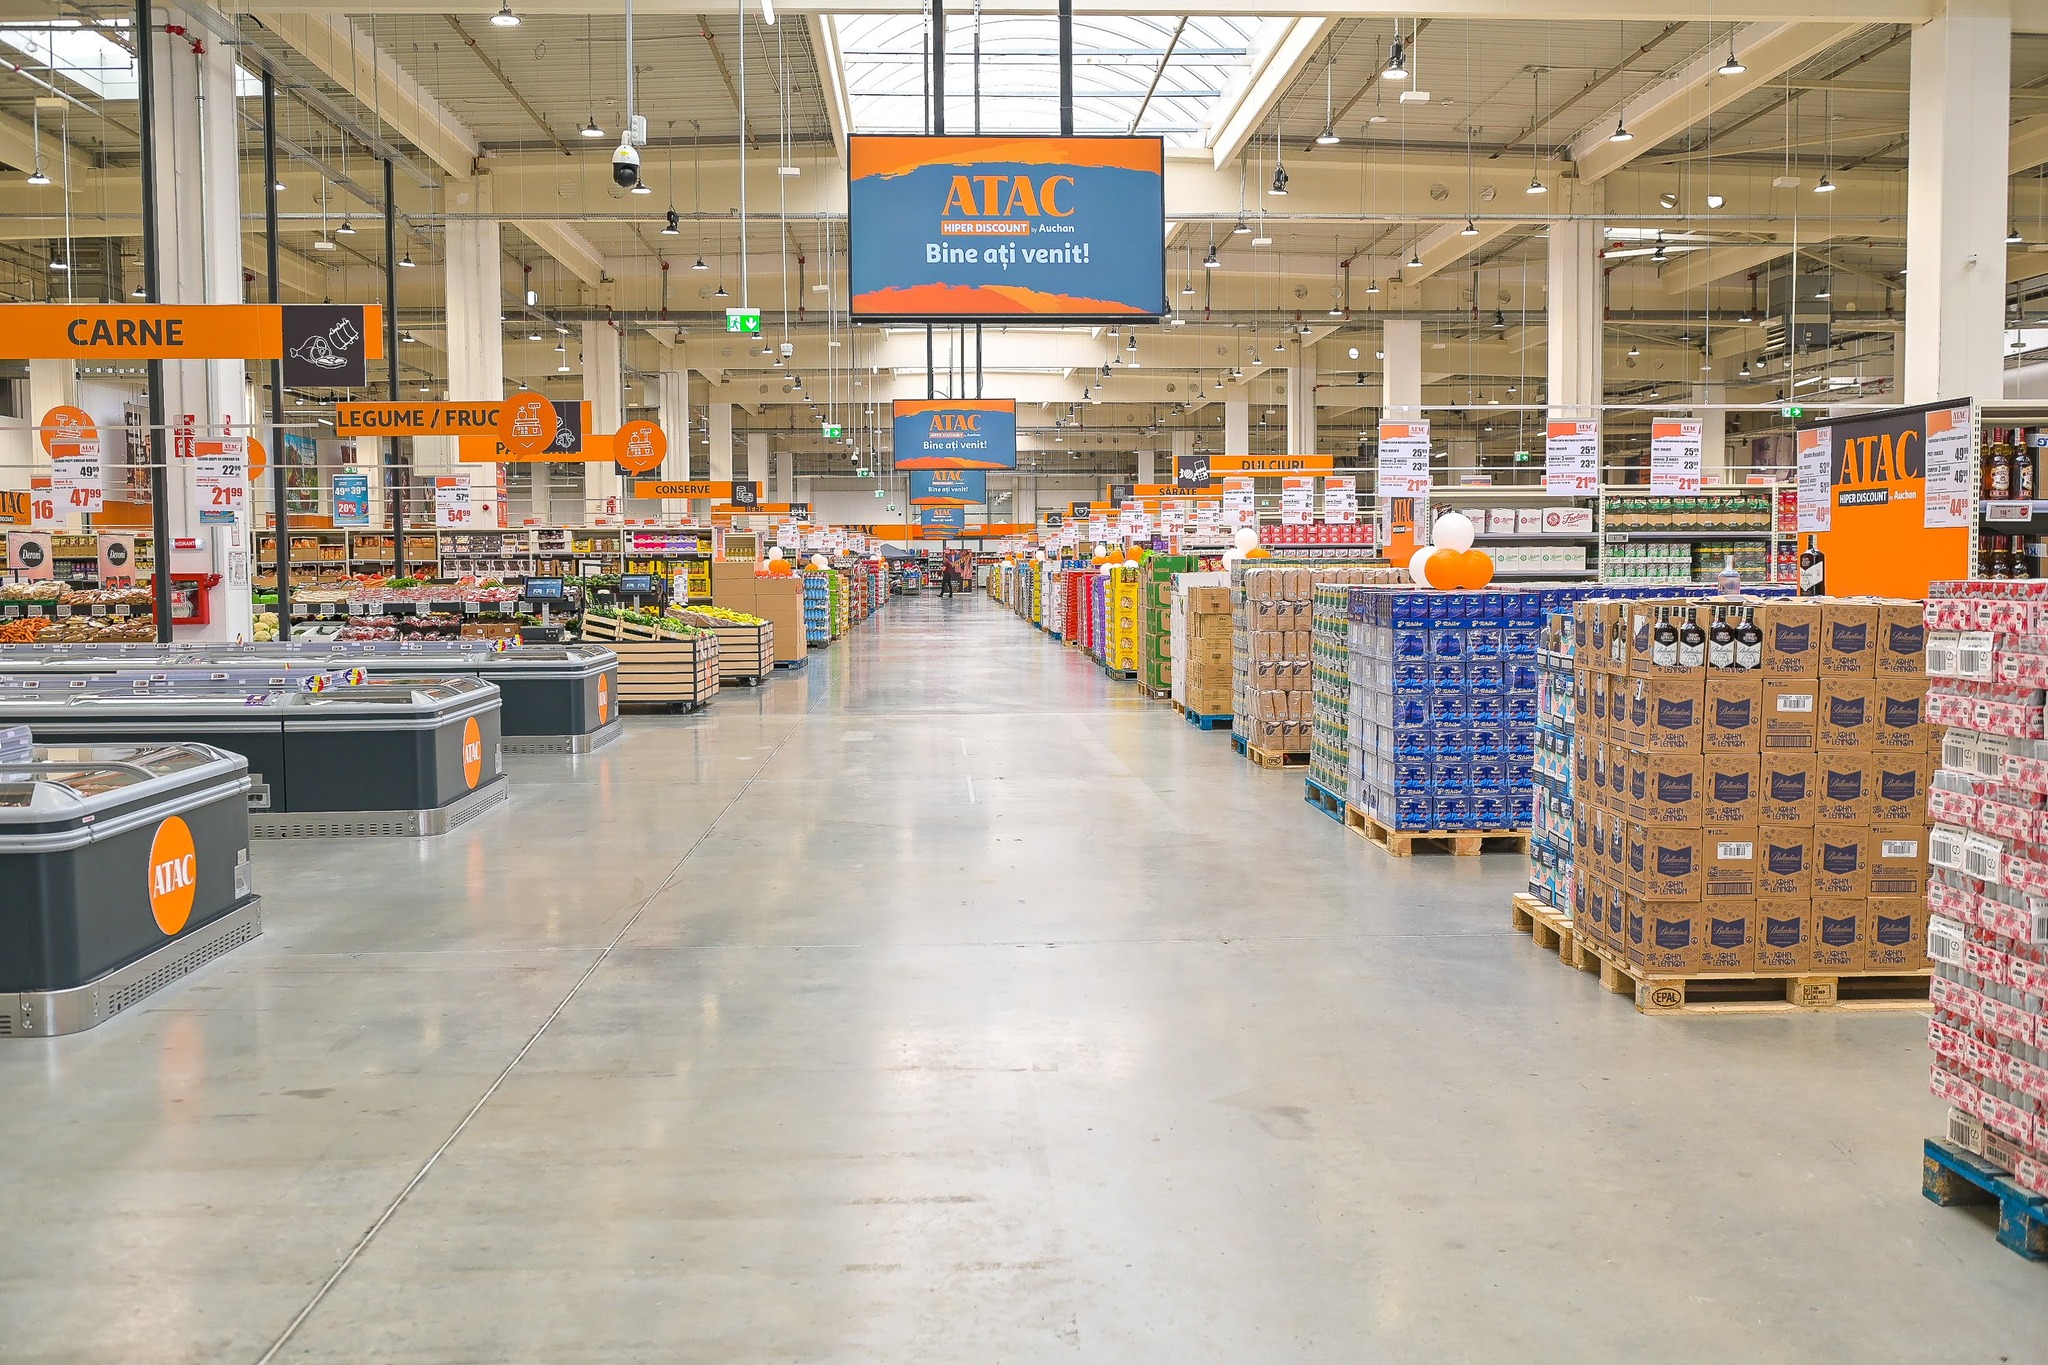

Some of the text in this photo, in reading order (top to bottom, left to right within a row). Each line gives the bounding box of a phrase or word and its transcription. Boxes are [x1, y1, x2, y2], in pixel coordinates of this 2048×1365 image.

[942, 176, 1075, 217] ATAC
[944, 223, 1074, 234] HIPER DISCOUNT by Auchan
[926, 242, 1090, 270] Bine ați venit!
[68, 318, 184, 346] CARNE
[338, 408, 500, 428] LEGUME / FRUC
[1952, 411, 1967, 420] ATAC
[930, 414, 982, 430] ATAC
[923, 441, 943, 449] Bine
[961, 441, 987, 449] venit!
[1838, 430, 1918, 486] ATAC
[655, 485, 711, 494] CONSERVE
[1840, 493, 1856, 504] HIPER
[1856, 491, 1888, 503] DISCOUNT
[1894, 490, 1916, 500] Auchan
[0, 492, 25, 514] TAC
[32, 500, 53, 519] 16
[338, 504, 356, 513] 20%
[1393, 498, 1412, 522] ATAC
[22, 550, 41, 559] Deroni
[110, 550, 125, 559] Deroni
[1890, 664, 1918, 672] LENNON
[1723, 732, 1742, 740] JOHN
[1660, 739, 1688, 748] LENNON
[1717, 739, 1745, 748] LENNON
[1832, 738, 1859, 746] LENNON
[464, 741, 480, 765] ATAC
[1664, 806, 1684, 814] JOHN
[1721, 806, 1740, 814] JOHN
[1660, 813, 1688, 821] LENNON
[1716, 813, 1744, 821] LENNON
[1773, 812, 1800, 821] LENNON
[153, 853, 194, 898] ATAC
[1664, 880, 1684, 888] JOHN
[1825, 884, 1852, 893] LENNON
[1660, 887, 1687, 895] LENNON
[1770, 885, 1797, 893] LENNON
[1657, 959, 1686, 968] LENNON
[1713, 959, 1740, 967] LENNON
[1769, 958, 1795, 966] LENNON
[1878, 956, 1905, 964] LENNON
[1657, 992, 1676, 1002] EPAL
